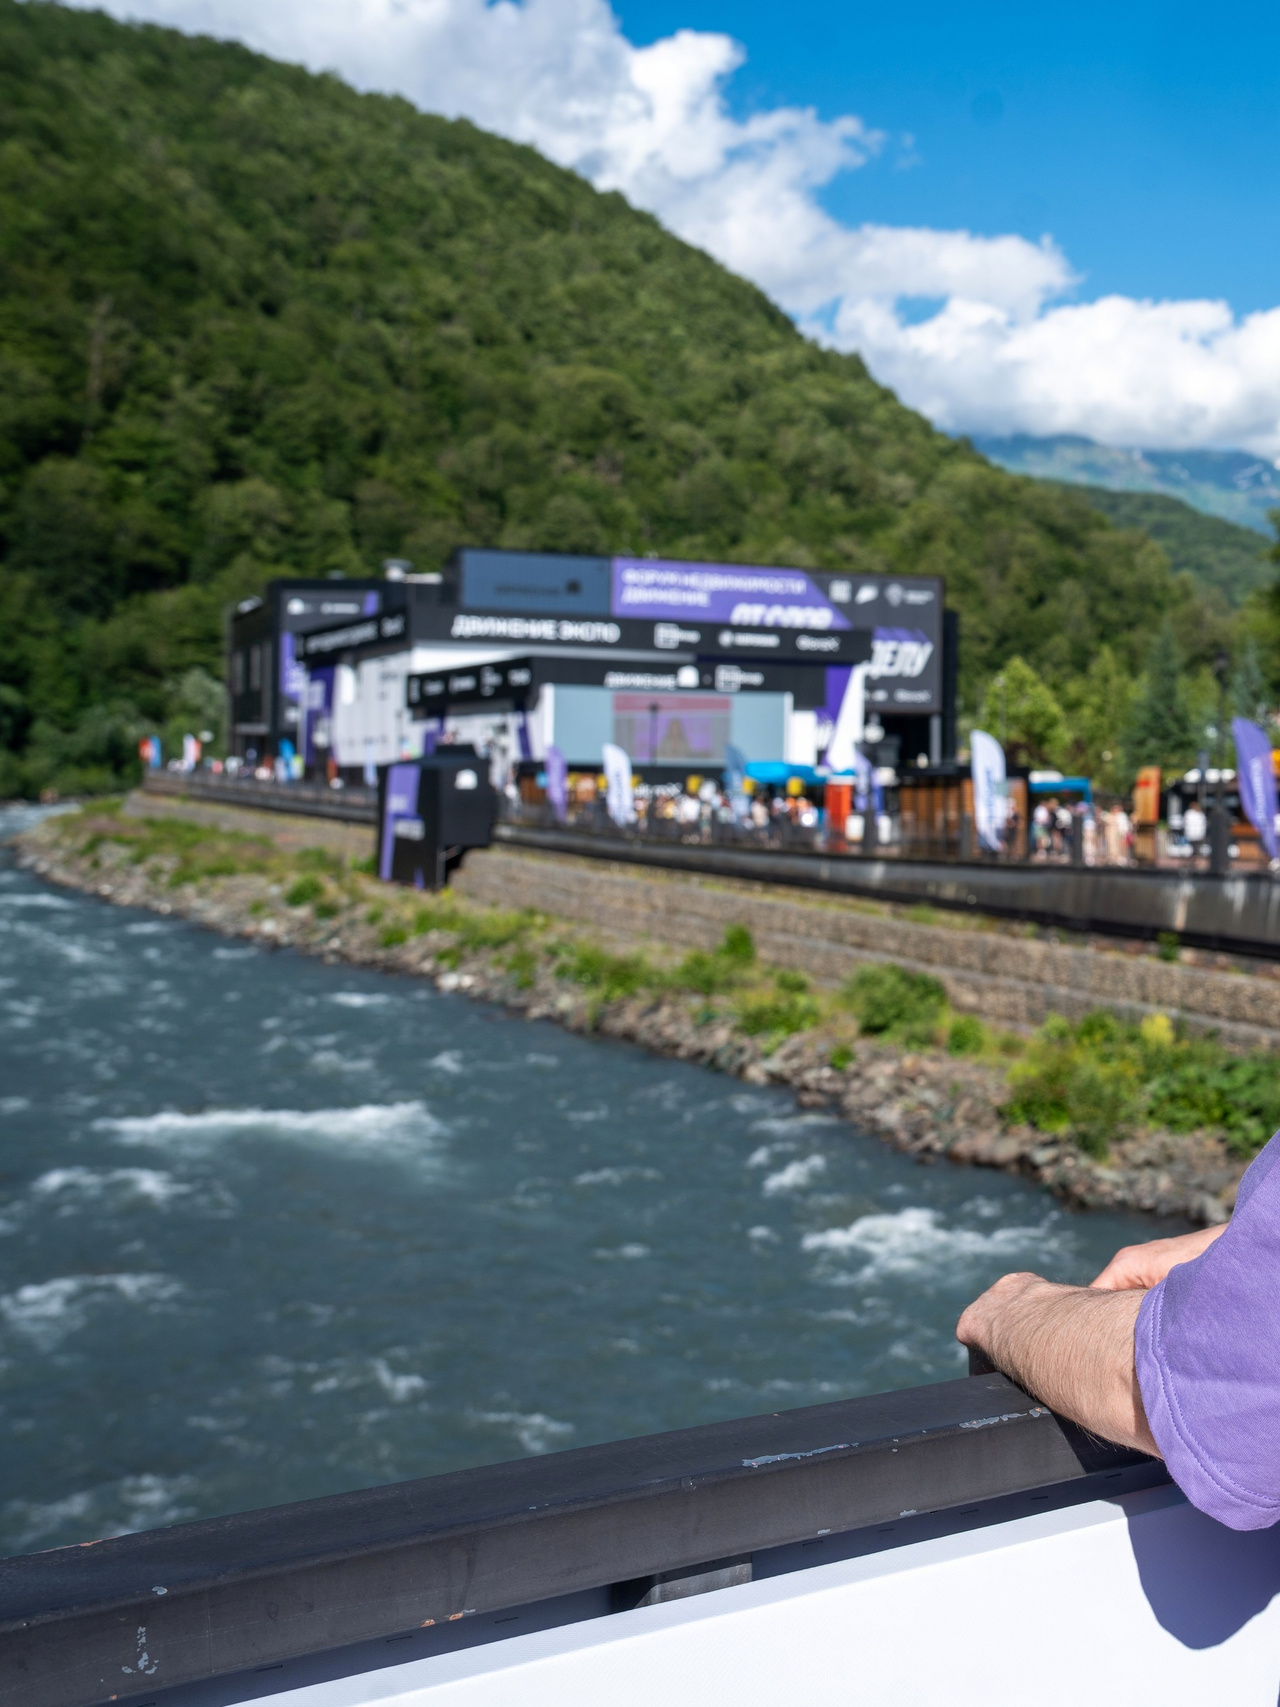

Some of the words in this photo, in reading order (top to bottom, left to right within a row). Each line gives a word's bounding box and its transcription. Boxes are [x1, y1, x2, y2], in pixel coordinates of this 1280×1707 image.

[451, 615, 557, 640] ДВИЖЕНИЕ
[559, 619, 621, 643] ЭКСПО
[604, 671, 676, 691] ДВИЖЕНИЕ
